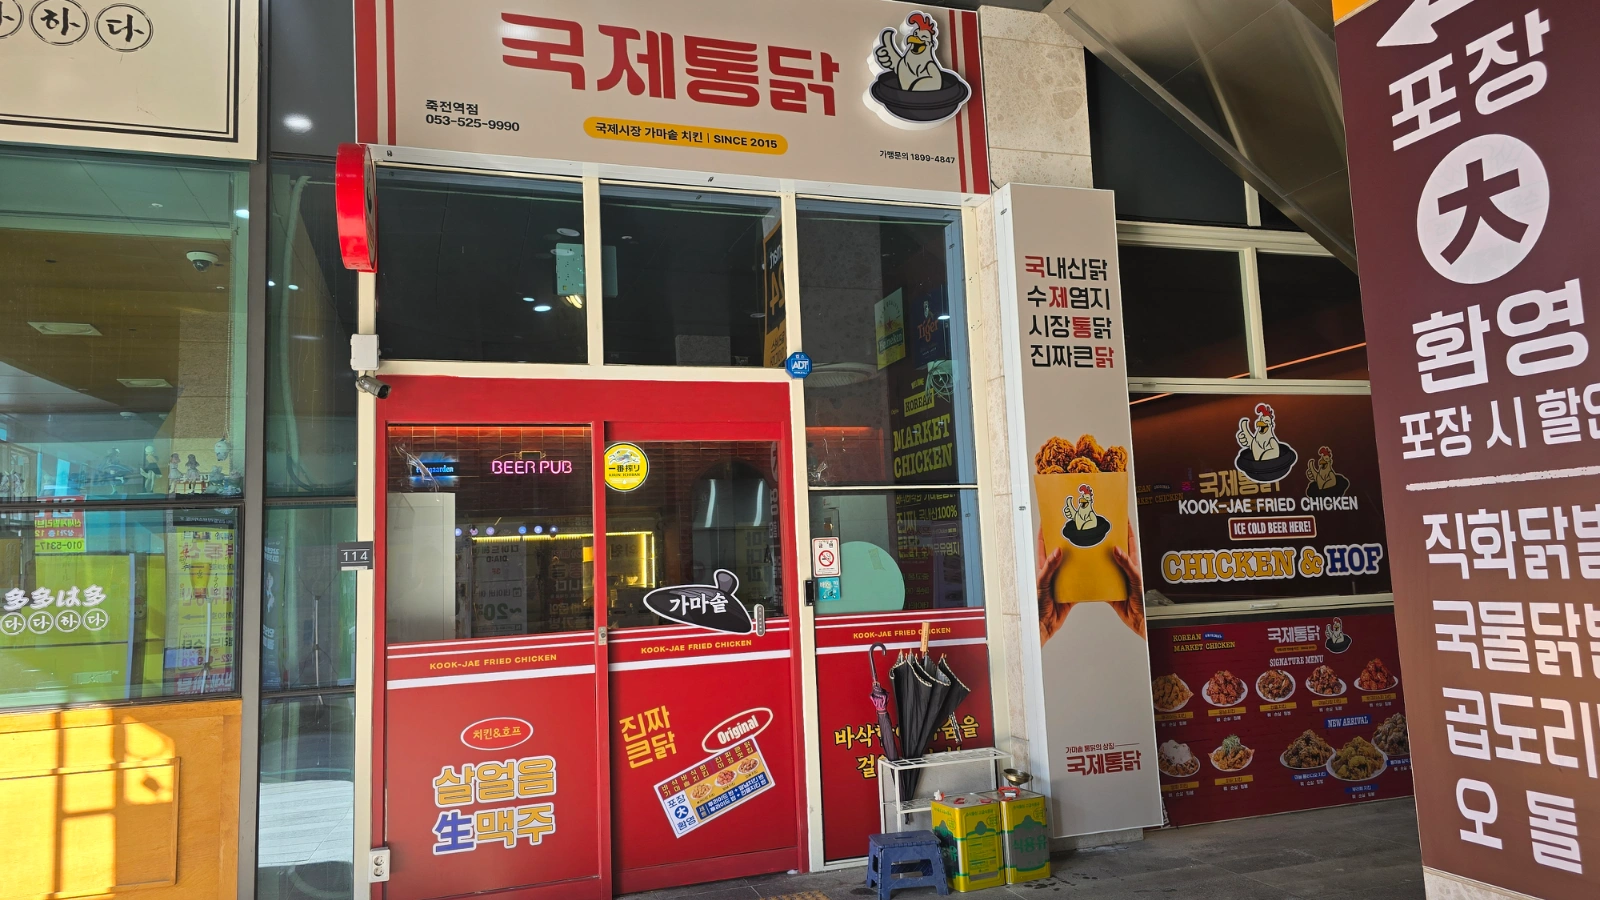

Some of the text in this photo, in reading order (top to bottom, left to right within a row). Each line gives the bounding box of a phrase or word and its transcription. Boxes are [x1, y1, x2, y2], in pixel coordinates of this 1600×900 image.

[501, 12, 840, 117] 국제통닭
[1388, 8, 1551, 152] 포장
[425, 99, 479, 116] 죽전역점
[425, 113, 520, 132] 053-525-9990
[595, 121, 778, 149] 국제시장 가마솥 치킨 SINCE 2015
[879, 150, 956, 164] 가맹문의 1899-4847
[1437, 157, 1530, 266] 大
[1025, 255, 1108, 281] 국내산닭
[1027, 285, 1111, 310] 수제염지
[918, 318, 939, 343] Tiger
[1029, 314, 1112, 339] 시장통닭
[1411, 278, 1589, 394] 환영
[792, 360, 809, 370] ADT
[1030, 344, 1114, 368] 진짜큰닭
[904, 393, 933, 413] KOREAN
[893, 414, 951, 452] MARKET
[1400, 405, 1473, 460] 포장
[1486, 396, 1527, 449] 시
[491, 460, 573, 474] BEER PUB
[608, 464, 641, 473] 一番搾り
[893, 443, 953, 479] CHICKEN
[1178, 496, 1359, 515] KOOK-JAE FRIED CHICKEN
[1233, 520, 1312, 535] ICE COLD BEER HERE!
[343, 551, 368, 562] 114
[1162, 544, 1383, 583] CHICKEN & HOF
[3, 583, 107, 612] 多多は多
[669, 592, 729, 616] 가마솥
[853, 627, 951, 640] KOOK-JAE FRIED CICKEN
[1172, 633, 1202, 642] KOREAN
[1267, 625, 1321, 643] 국제통닭
[640, 639, 752, 654] KOOK-JAE FRIED CHICKEN
[1173, 641, 1236, 653] MARKET CHICKEN
[429, 654, 557, 670] KOOK-JAE FRIED CHICKEN
[1269, 654, 1324, 668] SIGNATURE MENU
[619, 705, 671, 743] 진짜
[717, 715, 759, 745] Original
[1327, 716, 1369, 728] NEW ARRIVAL
[1442, 687, 1600, 779] 곱도리
[472, 726, 522, 741] 치킨&호프
[625, 731, 677, 769] 큰닭
[1066, 742, 1115, 754] 가마솥 통닭의 상징
[1066, 750, 1142, 776] 국제통닭
[433, 756, 556, 807] 살얼음
[667, 793, 687, 809] 포장
[675, 805, 689, 819] 大
[433, 804, 555, 853] 生맥주
[1013, 834, 1048, 854] 식용유
